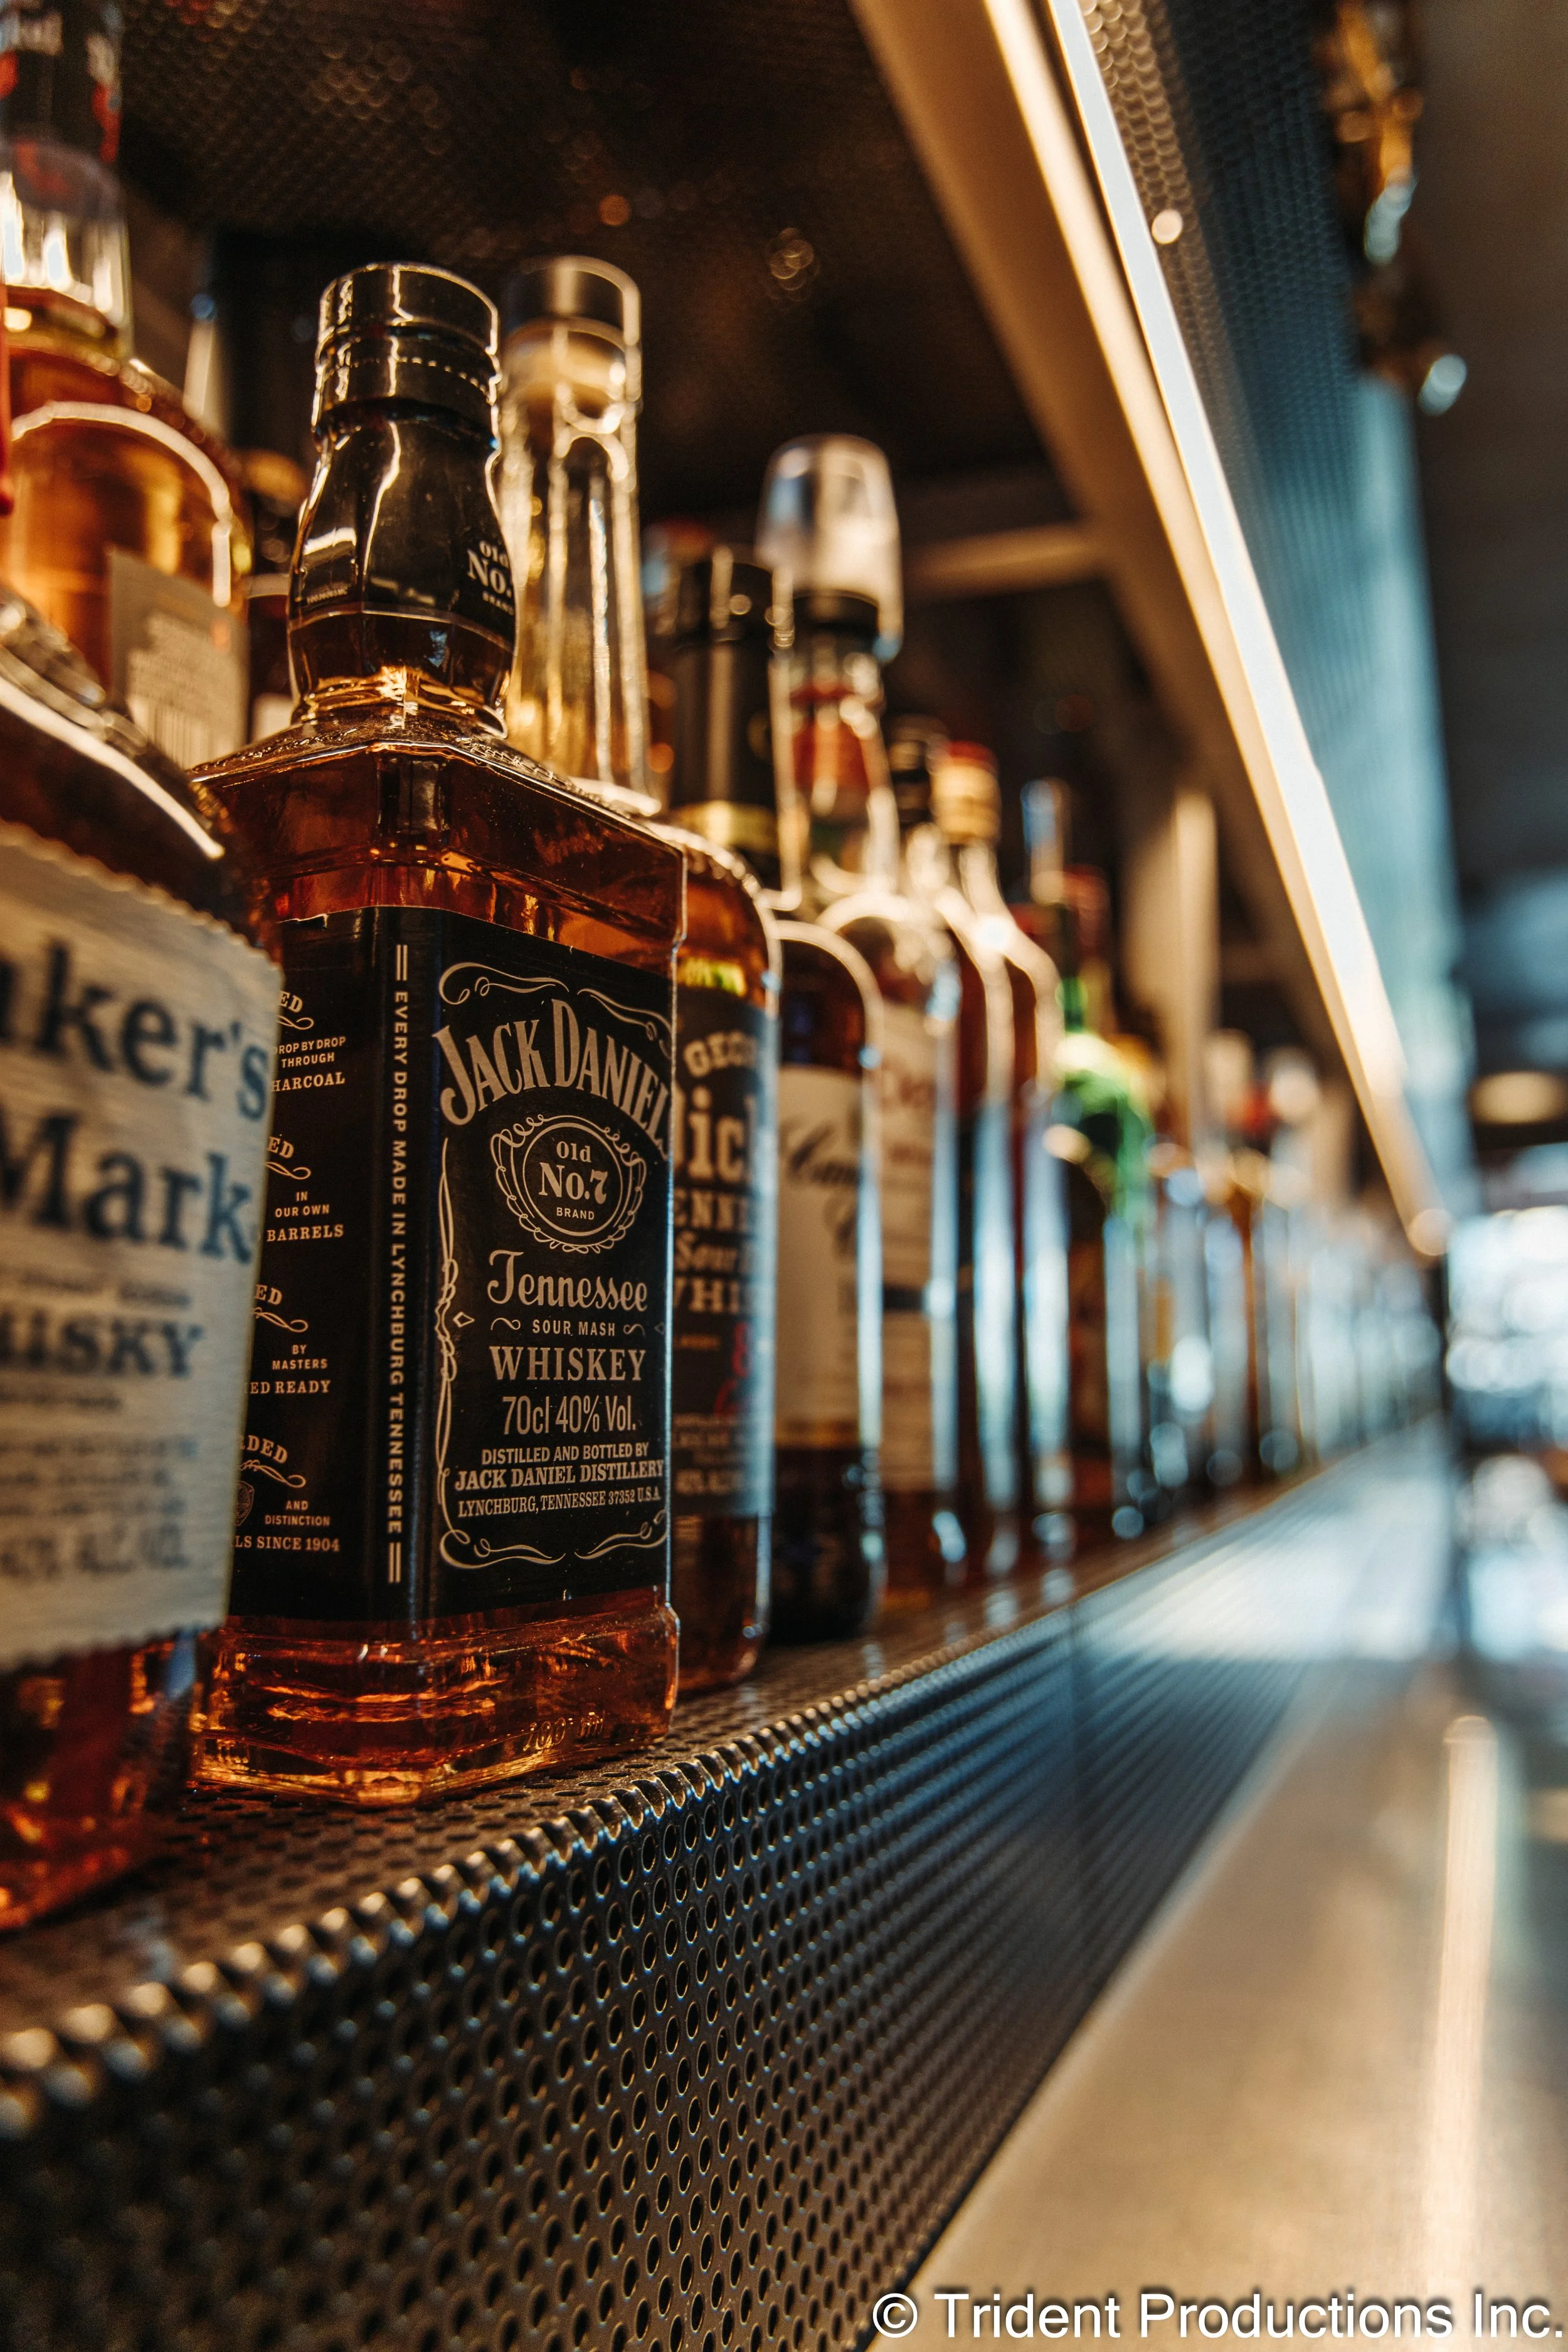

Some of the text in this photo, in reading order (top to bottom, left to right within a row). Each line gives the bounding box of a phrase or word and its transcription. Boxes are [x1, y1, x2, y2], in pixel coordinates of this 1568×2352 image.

[280, 990, 303, 1013] ED
[301, 1040, 315, 1051] BY
[317, 1036, 346, 1049] DROP
[281, 1052, 335, 1068] THROUGH
[272, 1071, 345, 1092] HARCOAL
[431, 1019, 551, 1126] JACK
[267, 1136, 294, 1158] ED
[556, 1142, 591, 1162] Old
[538, 1162, 608, 1204] No.7
[296, 1192, 308, 1201] IN
[275, 1204, 330, 1218] OUR OWN
[556, 1207, 595, 1221] BRAND
[266, 1224, 344, 1242] BARRELS
[388, 990, 408, 1534] EVERY DROP MADE IN LYNCHBURG TENNESSEE
[487, 1249, 649, 1312] Tennessee
[254, 1285, 282, 1305] ED
[532, 1320, 616, 1337] SOUR MASH
[292, 1345, 307, 1355] BY
[271, 1359, 328, 1370] MASTERS
[489, 1345, 647, 1381] WHISKEY
[250, 1380, 332, 1394] ED READY
[502, 1395, 637, 1435] 70cl 40% Vol.
[241, 1434, 288, 1464] DED
[482, 1442, 650, 1466] DISTILLED AND BOTTLED BY
[455, 1469, 510, 1491] JACK
[511, 1465, 576, 1488] DANIEL
[580, 1459, 664, 1483] DISTILLERY
[285, 1500, 309, 1511] AND
[457, 1496, 539, 1518] LYNCHBURG,
[540, 1491, 607, 1511] TENNESSEE
[608, 1488, 635, 1505] 37352
[264, 1514, 332, 1527] DISTINCTION
[235, 1535, 341, 1552] LS SINCE 1904
